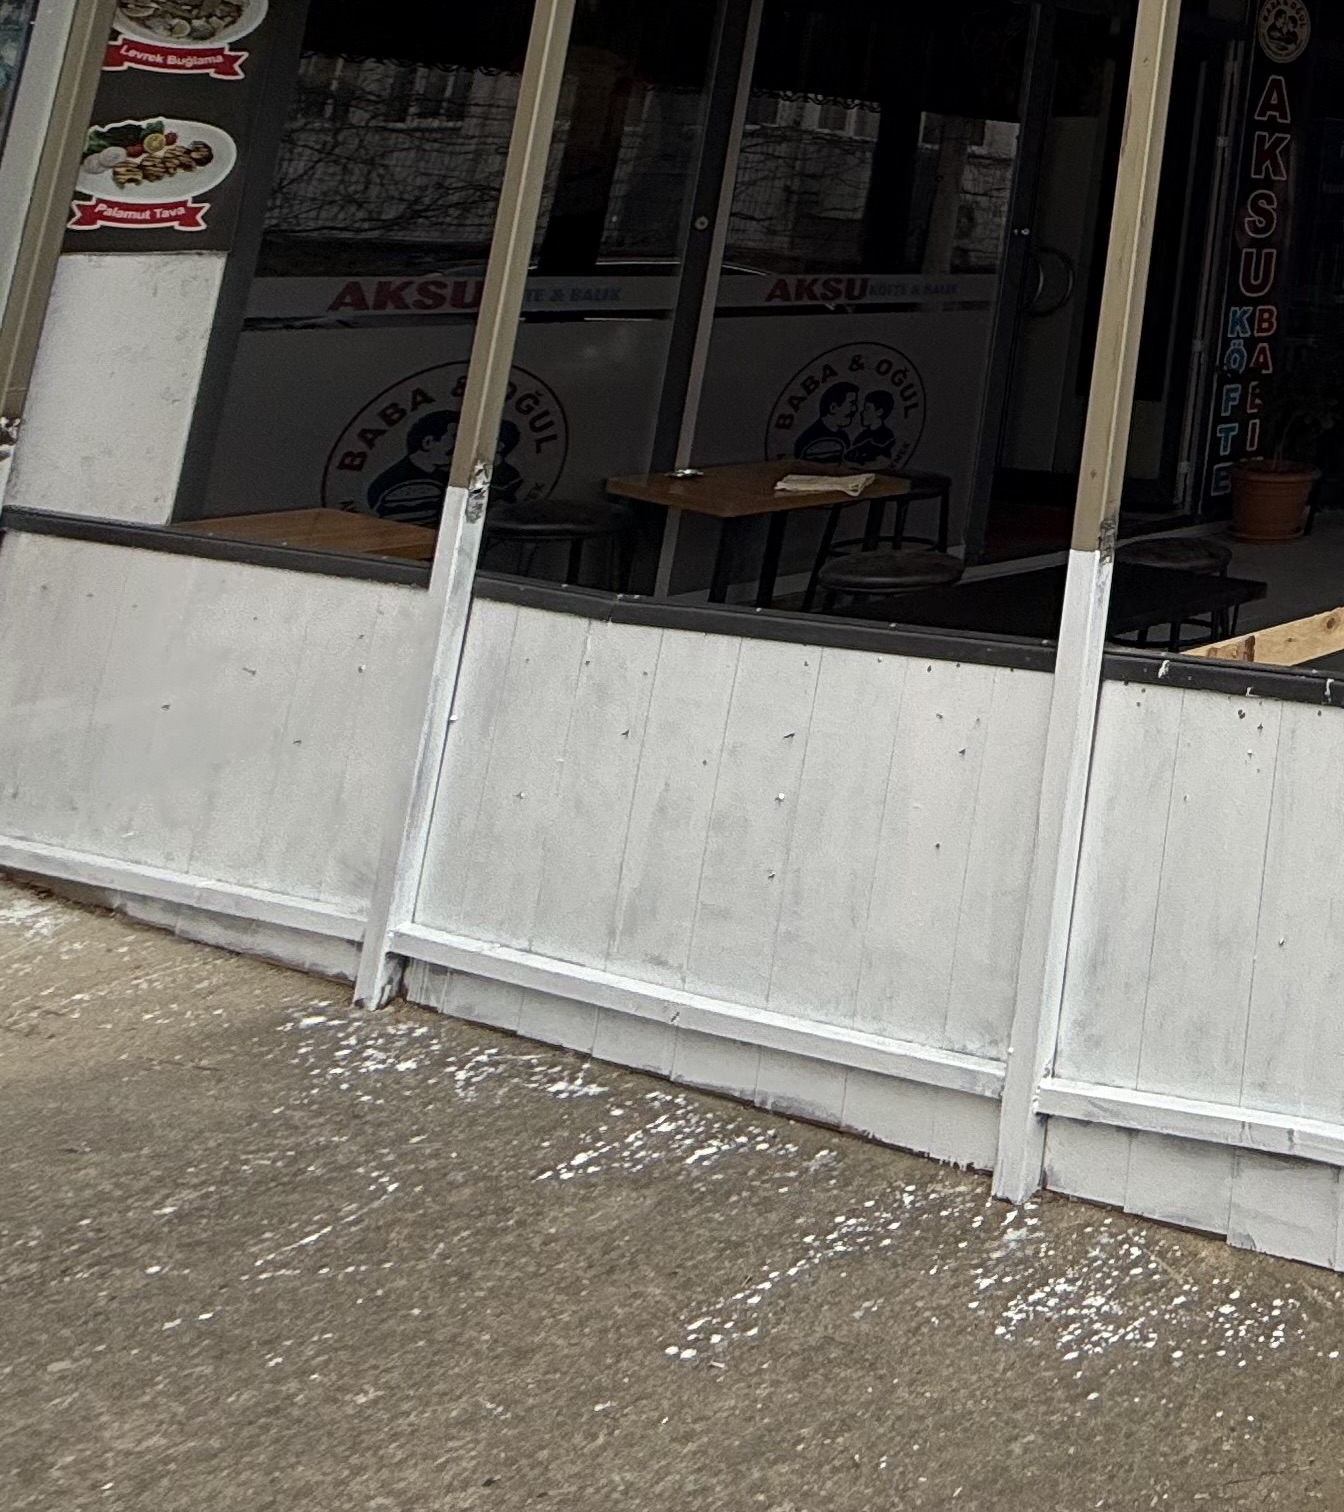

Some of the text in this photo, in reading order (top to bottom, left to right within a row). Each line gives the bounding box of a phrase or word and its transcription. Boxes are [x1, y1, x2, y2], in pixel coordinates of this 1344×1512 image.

[119, 44, 224, 68] Levrek Buğlama
[1238, 74, 1291, 297] AKSU
[94, 203, 186, 219] Palamut Tava
[326, 280, 485, 312] AKSU
[765, 277, 870, 301] AKSU
[775, 354, 919, 430] BABA & OĞUL
[336, 388, 436, 471] BABA
